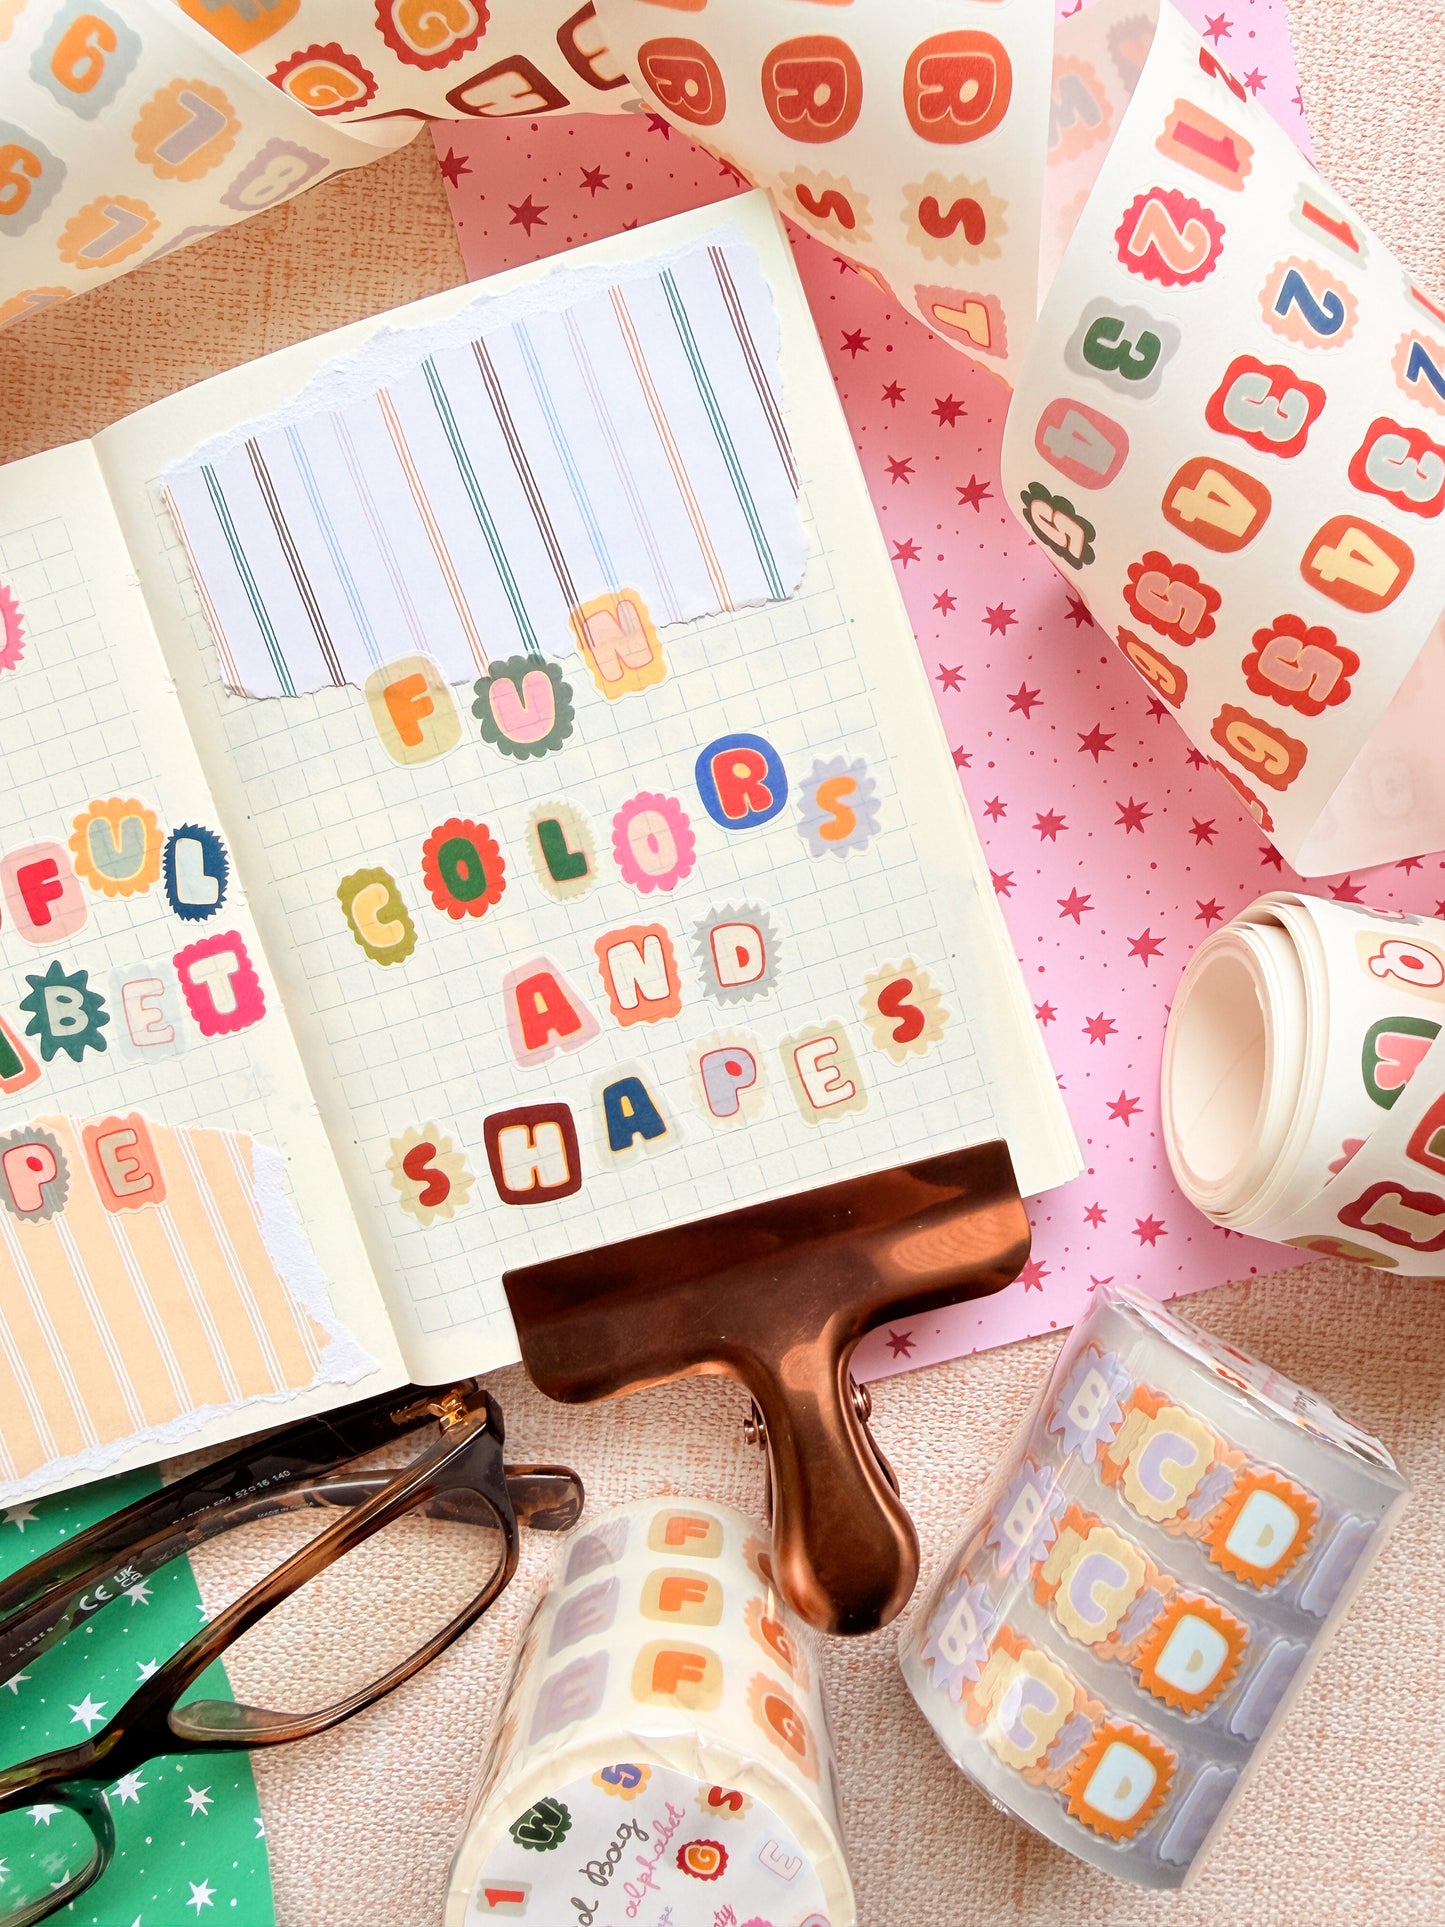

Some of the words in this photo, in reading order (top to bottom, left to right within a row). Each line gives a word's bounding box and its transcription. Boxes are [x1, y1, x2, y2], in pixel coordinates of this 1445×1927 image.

[50, 13, 118, 95] 6
[154, 90, 229, 166] 7
[646, 54, 713, 116] R
[772, 57, 848, 128] R
[916, 52, 998, 127] R
[79, 204, 147, 259] 7
[795, 183, 856, 230] S
[917, 195, 986, 246] S
[1127, 198, 1212, 274] 2
[1273, 268, 1345, 336] 2
[1082, 316, 1162, 381] 3
[1222, 371, 1310, 442] 3
[1365, 432, 1445, 503] 3
[1042, 408, 1117, 476] 4
[1170, 468, 1258, 538] 4
[1311, 526, 1401, 597] 4
[382, 600, 655, 747] FUN
[1135, 570, 1208, 636] 5
[1257, 635, 1344, 703] 5
[351, 746, 858, 948] COLORS
[514, 922, 767, 1051] AND
[402, 977, 926, 1208] SHAPES
[664, 1516, 711, 1546] F
[1137, 1430, 1200, 1503] C
[1224, 1489, 1301, 1570] D
[658, 1577, 709, 1612] F
[1068, 1550, 1130, 1627] C
[1153, 1613, 1231, 1695] D
[651, 1650, 707, 1695] F
[1001, 1672, 1060, 1753] C
[1082, 1740, 1159, 1822] D
[623, 1801, 686, 1918] alphabet
